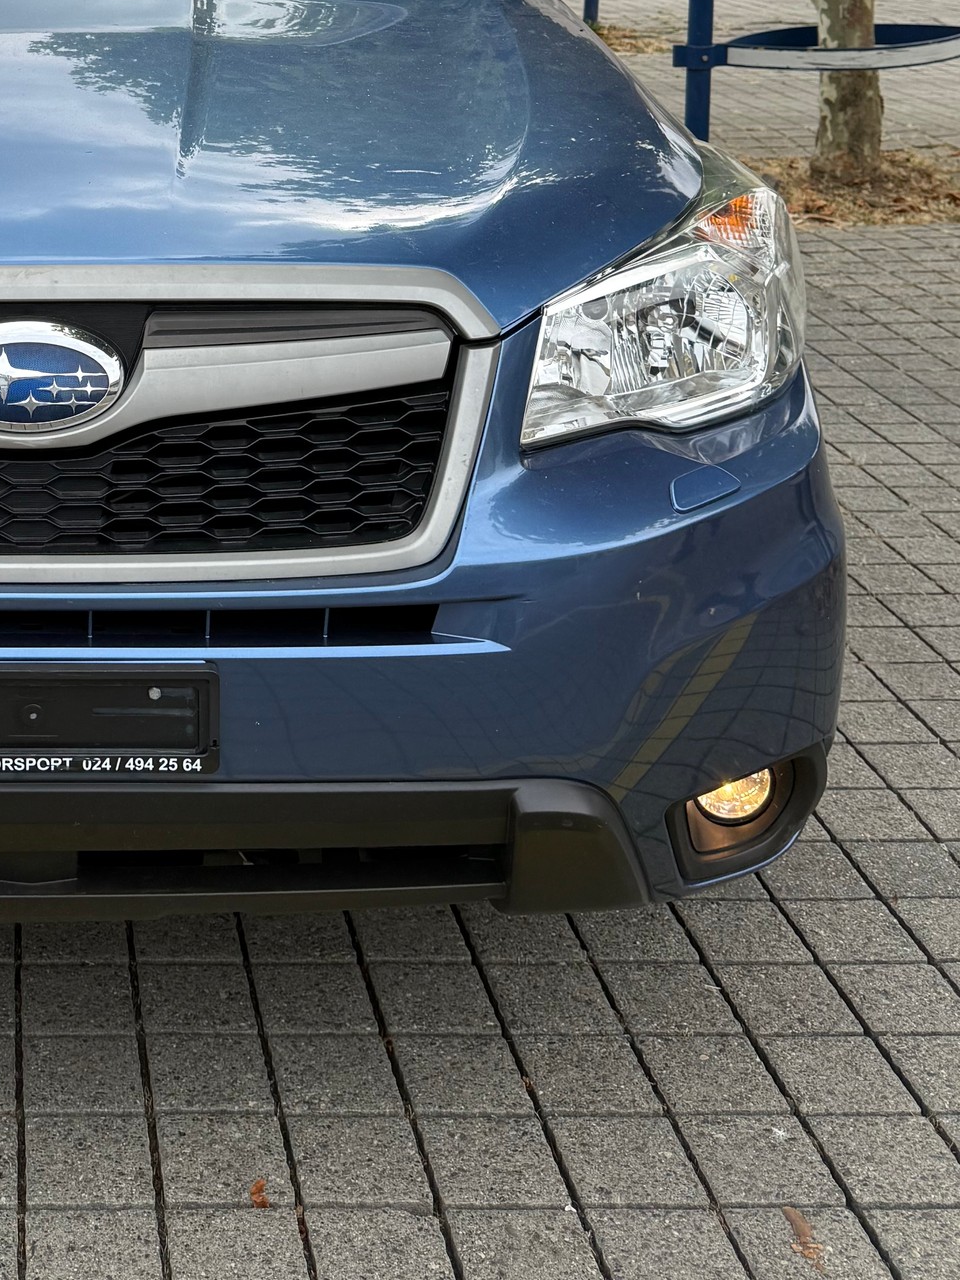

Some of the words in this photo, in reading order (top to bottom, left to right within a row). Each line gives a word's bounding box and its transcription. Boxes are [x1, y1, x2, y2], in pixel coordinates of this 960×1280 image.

[82, 757, 111, 771] 024
[114, 757, 122, 771] /
[124, 757, 154, 771] 494
[158, 758, 178, 771] 25
[182, 758, 202, 772] 64
